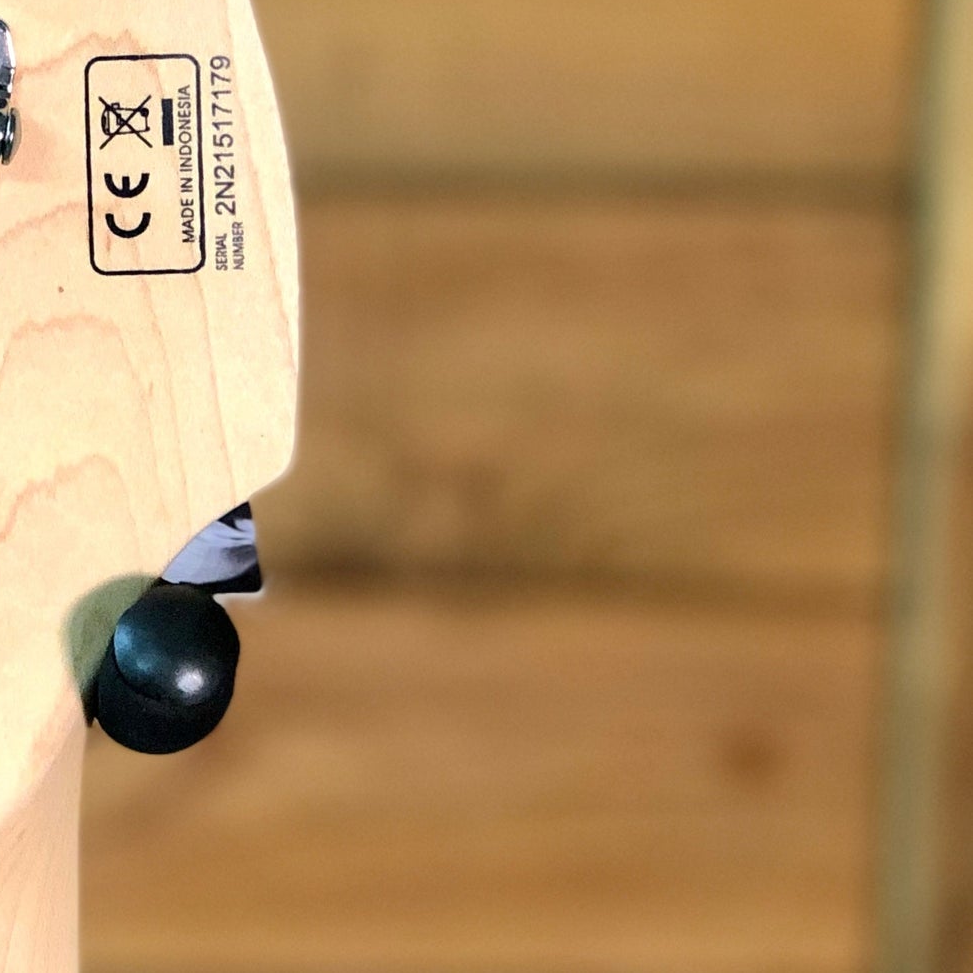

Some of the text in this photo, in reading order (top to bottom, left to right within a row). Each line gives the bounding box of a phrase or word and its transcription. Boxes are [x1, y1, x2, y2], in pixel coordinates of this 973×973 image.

[178, 85, 195, 243] MADE IN INDONESIA
[210, 55, 236, 215] 2N21517179
[216, 233, 227, 270] SERIAL
[233, 221, 244, 270] NUMBER
